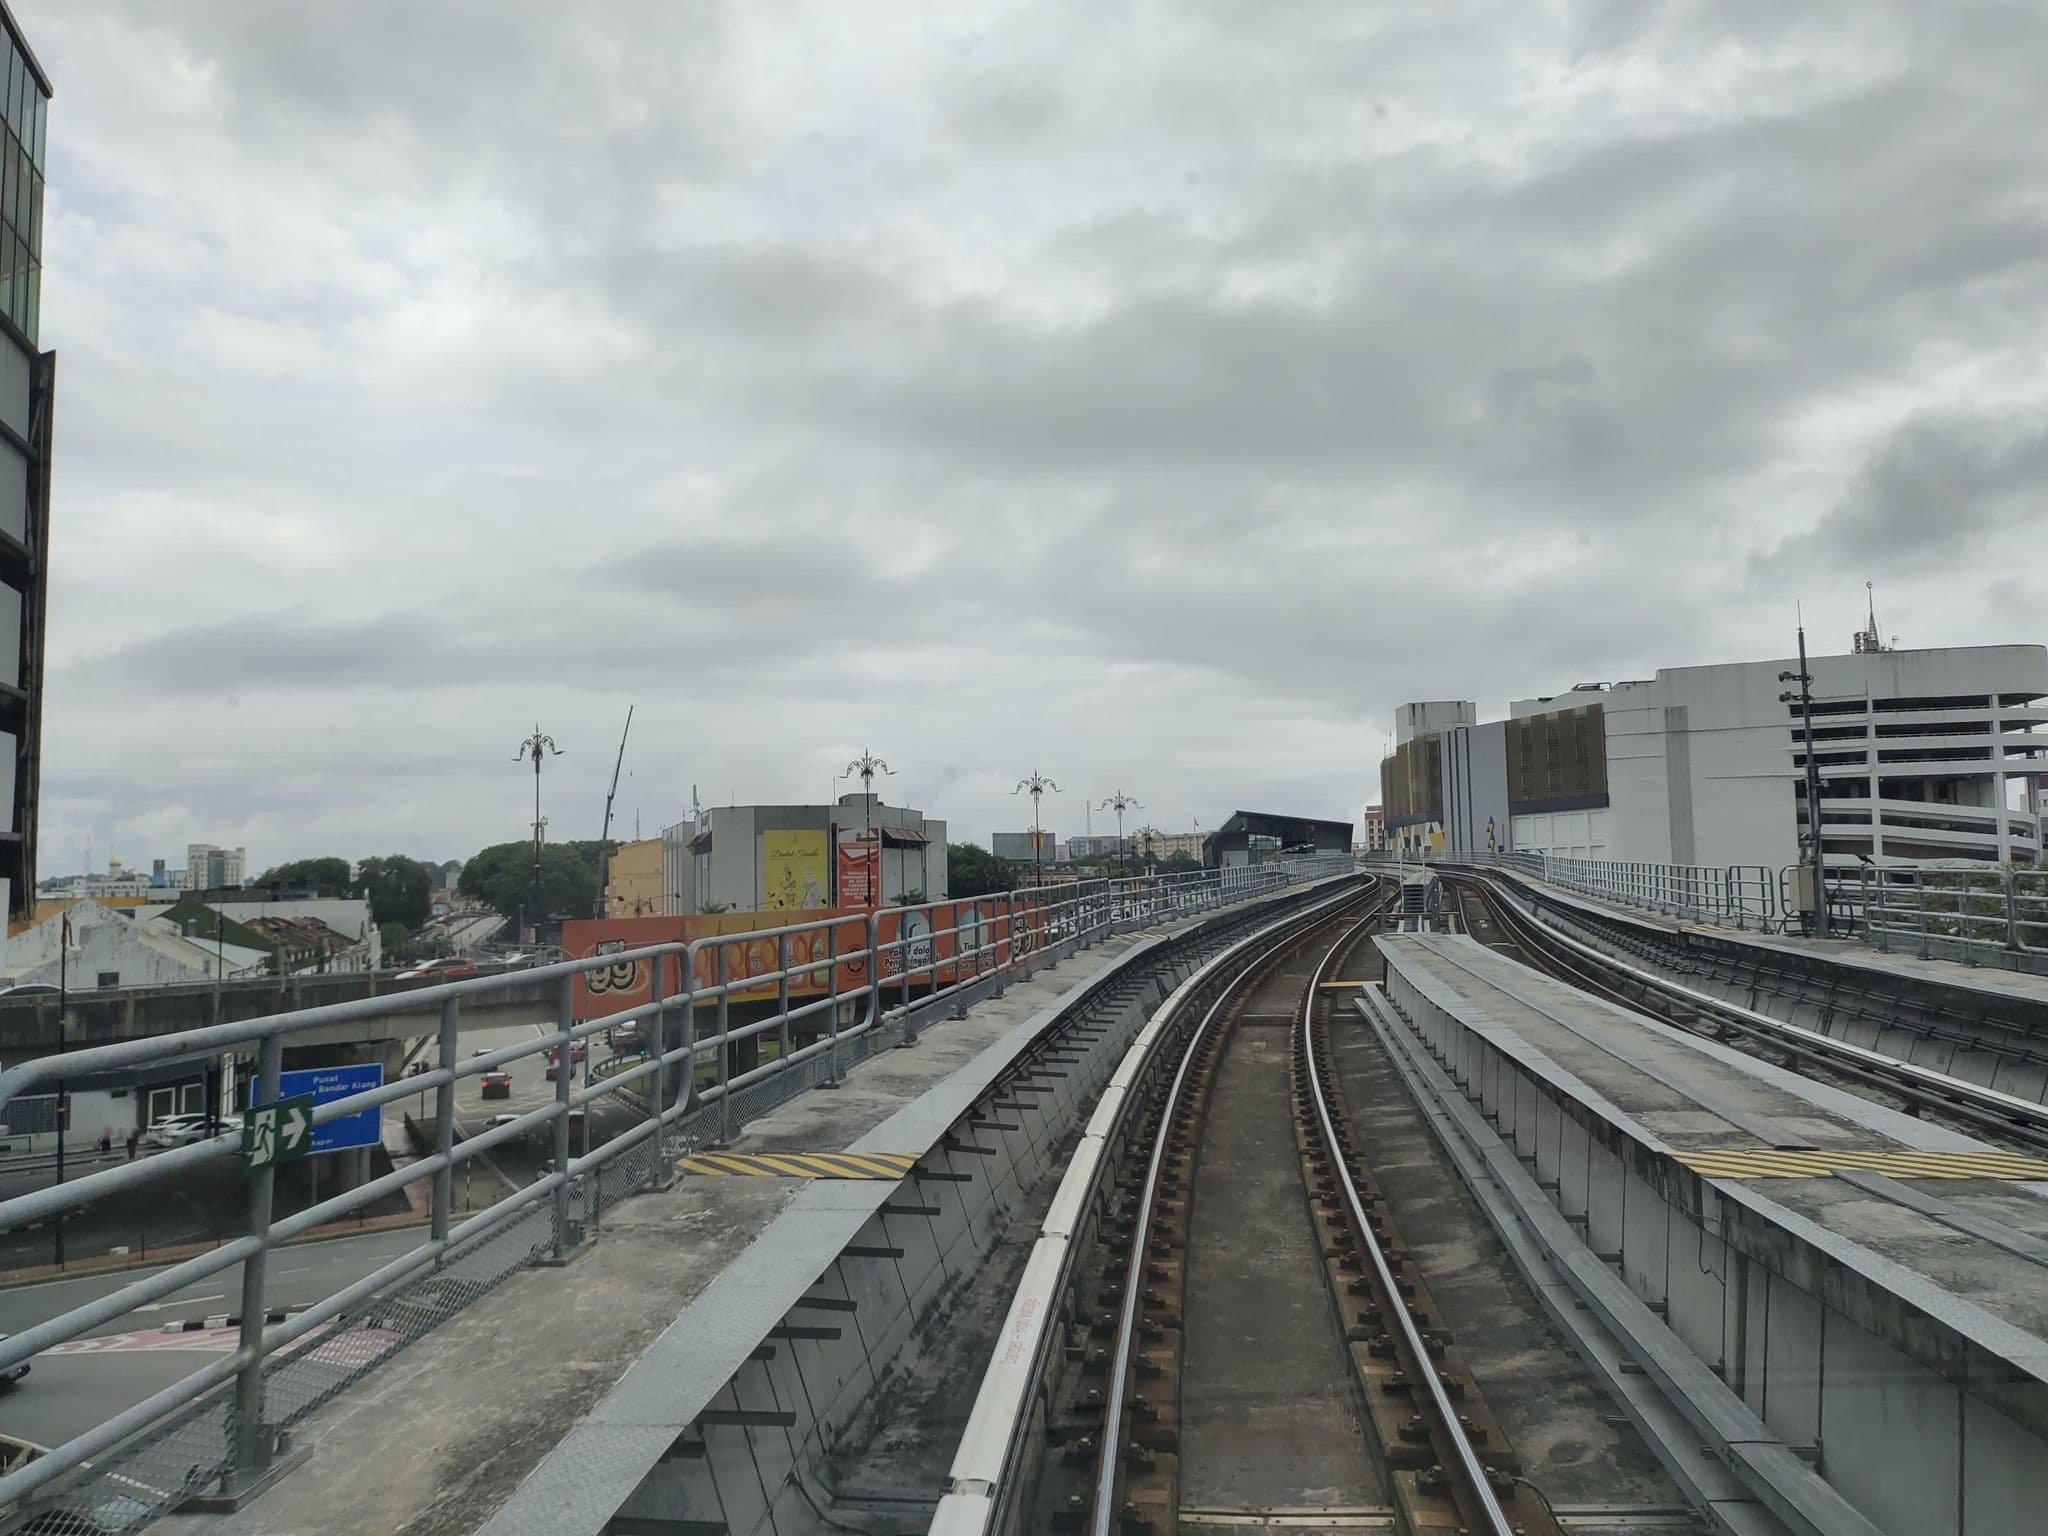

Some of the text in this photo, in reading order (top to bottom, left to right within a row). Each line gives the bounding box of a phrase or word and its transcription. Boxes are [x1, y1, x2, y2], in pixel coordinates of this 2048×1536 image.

[313, 1075, 338, 1084] Pusat
[318, 1081, 377, 1093] Bandar Klang
